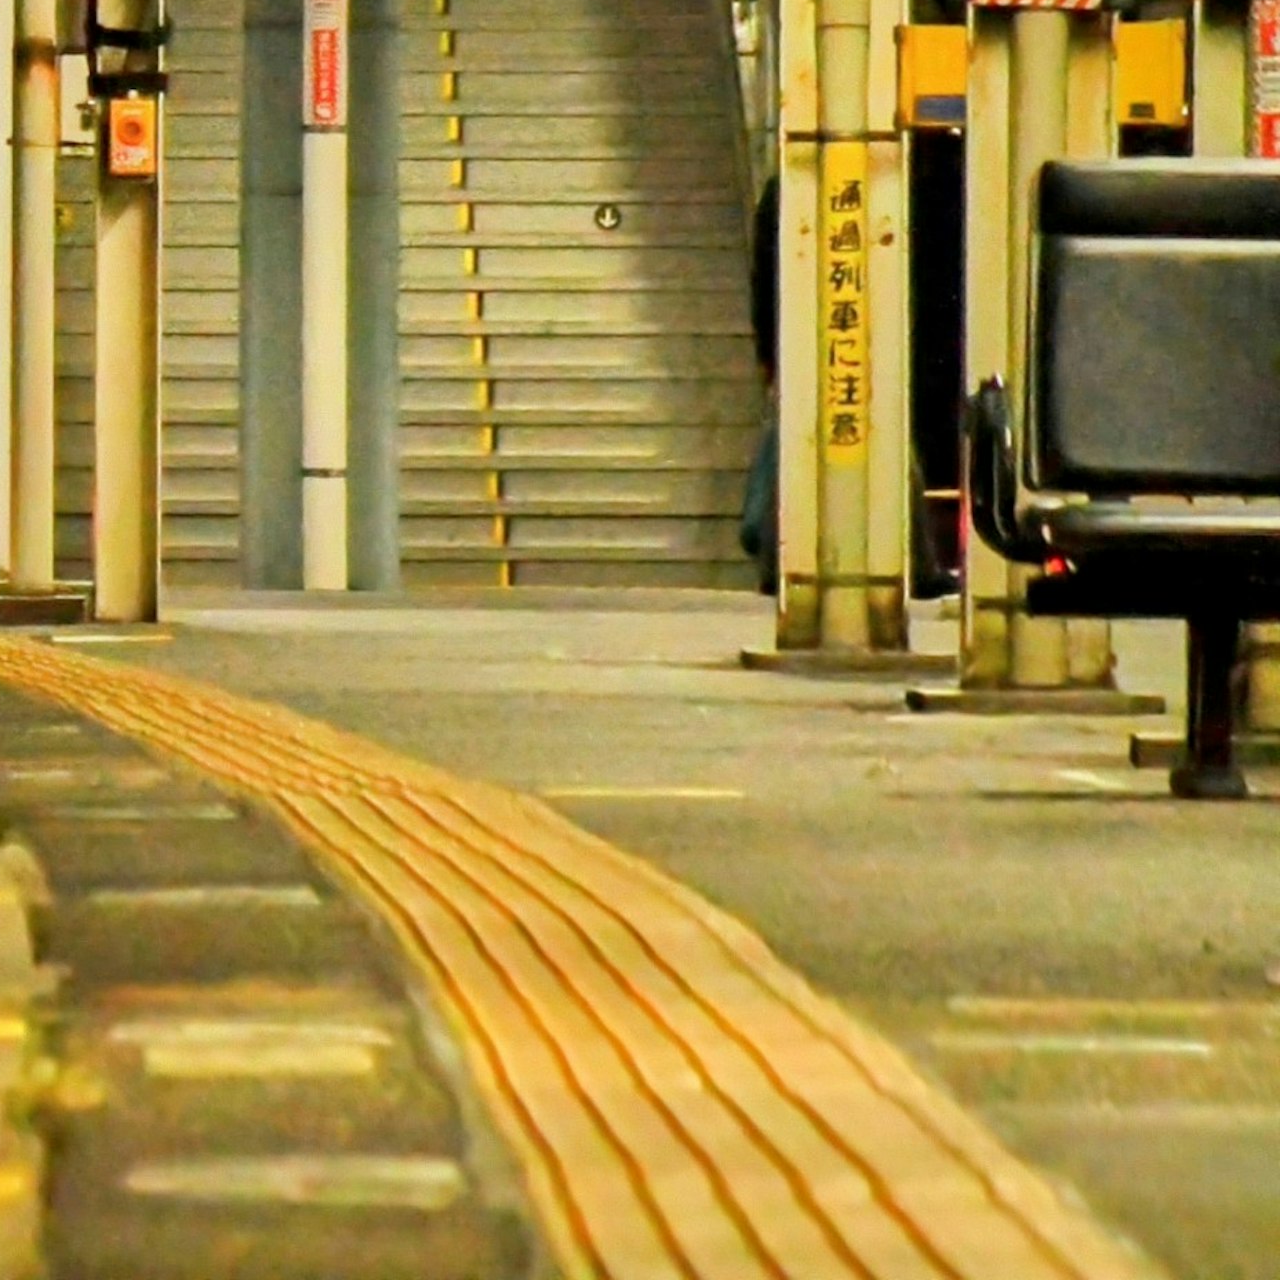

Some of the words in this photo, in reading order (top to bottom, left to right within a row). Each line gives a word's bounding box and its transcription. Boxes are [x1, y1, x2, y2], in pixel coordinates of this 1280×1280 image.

[828, 179, 864, 446] 通過列車に注意
